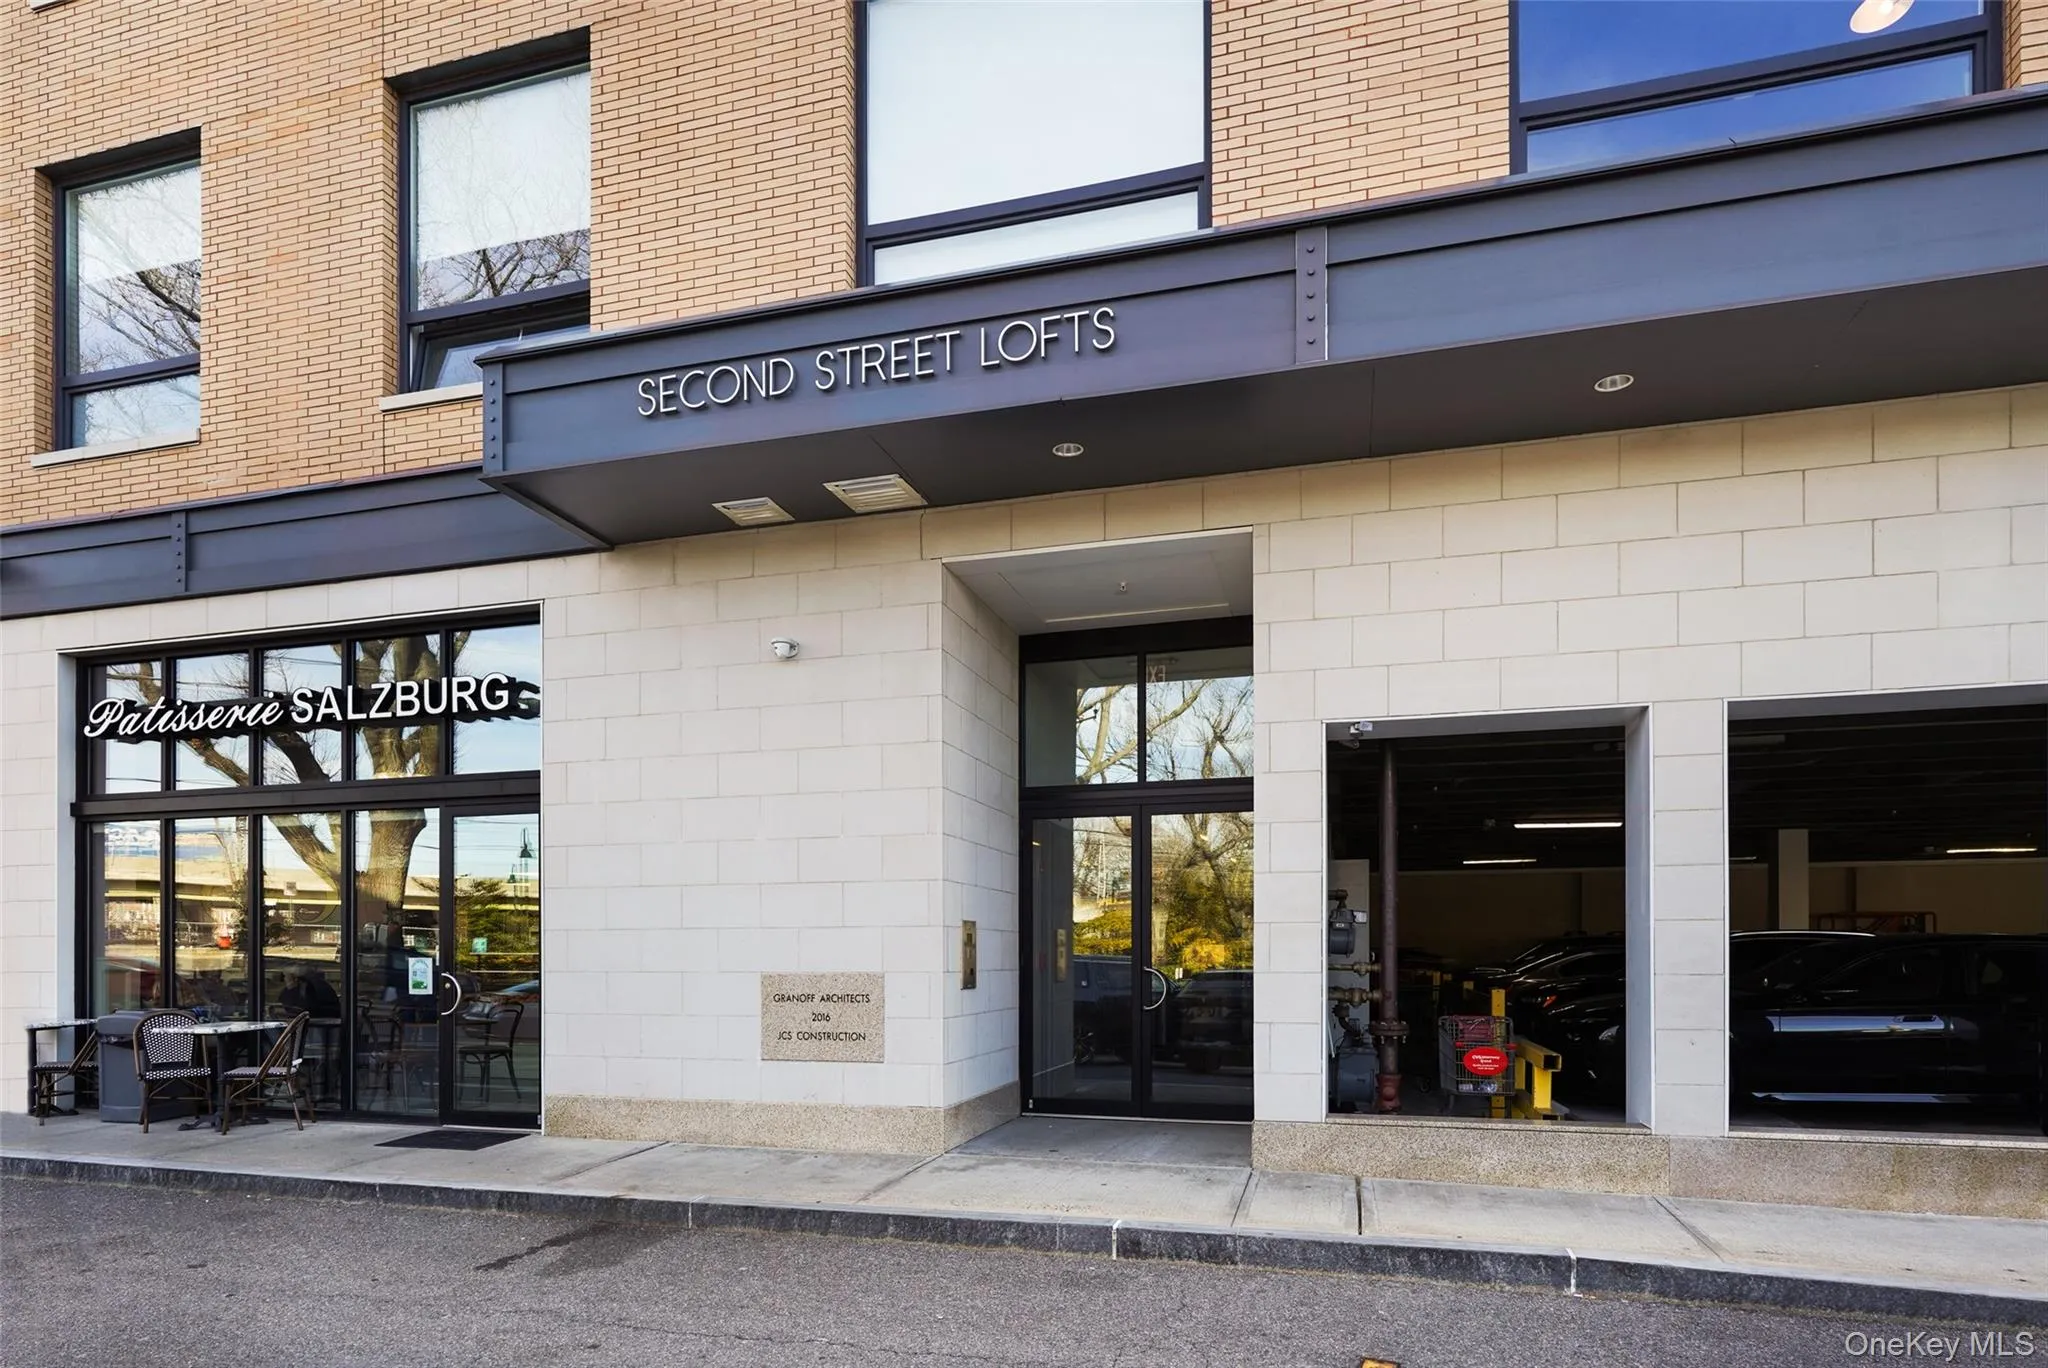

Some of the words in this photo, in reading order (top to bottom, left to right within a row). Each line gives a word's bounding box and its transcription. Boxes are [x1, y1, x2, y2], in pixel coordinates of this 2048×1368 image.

[638, 357, 794, 417] SECOND
[815, 329, 960, 390] STREET
[980, 307, 1115, 368] LOFTS
[83, 690, 284, 737] Patisserie
[291, 672, 509, 723] SALZBURG
[773, 993, 816, 1003] GRANOFF
[819, 993, 870, 1004] ARCHITECTS
[811, 1012, 831, 1022] 2016
[777, 1031, 792, 1041] JCS
[796, 1031, 866, 1042] CONSTRUCTION
